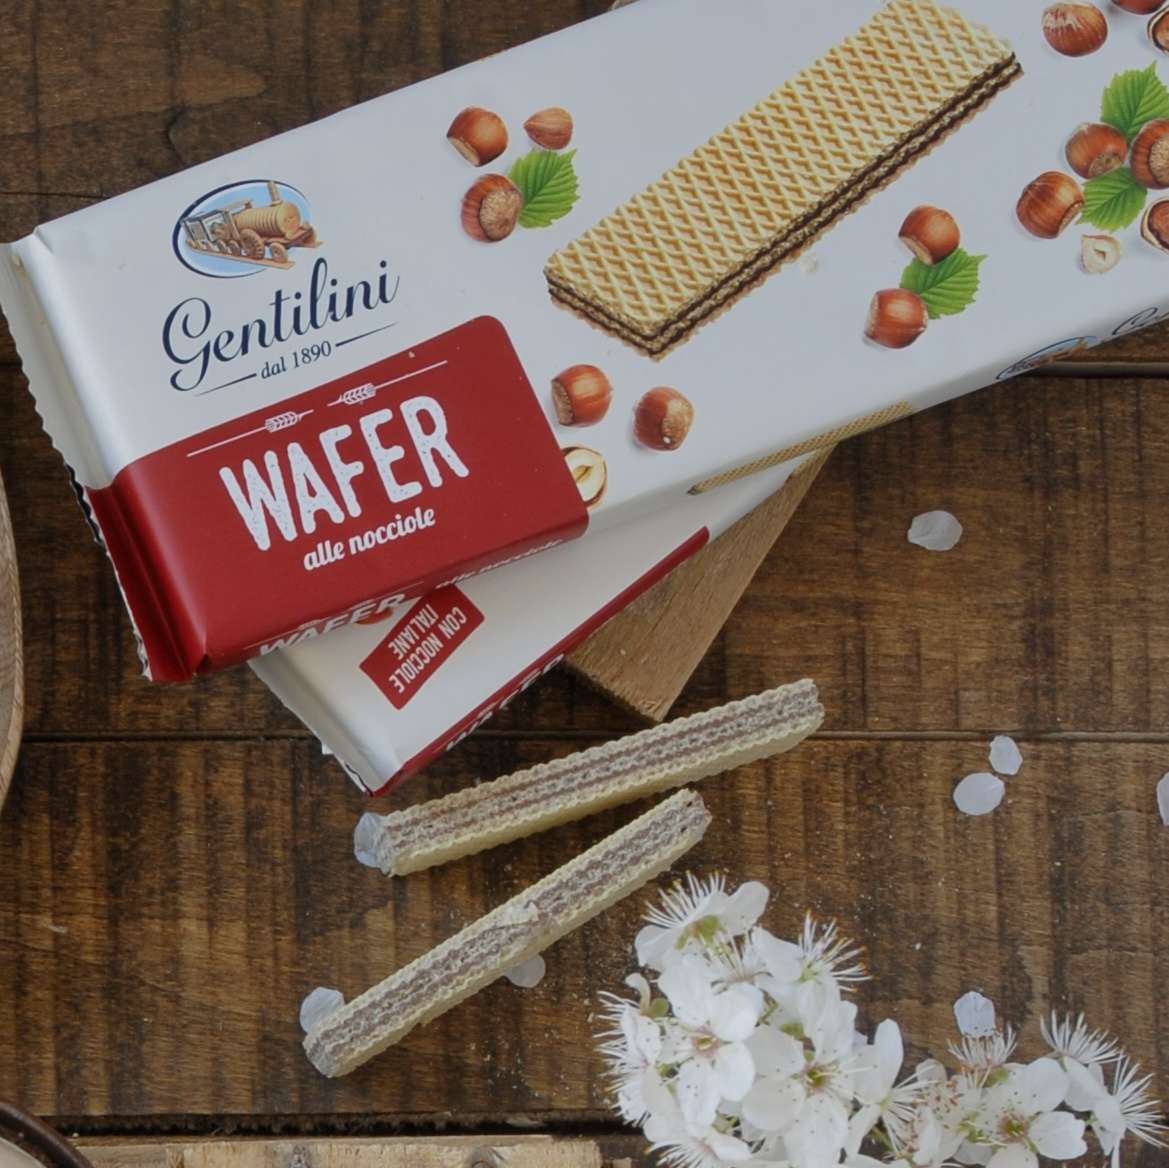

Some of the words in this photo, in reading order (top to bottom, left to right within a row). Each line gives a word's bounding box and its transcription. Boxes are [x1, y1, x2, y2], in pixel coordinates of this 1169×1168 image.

[162, 257, 400, 391] Gentilini
[261, 357, 287, 380] dal
[293, 340, 332, 369] 1890
[219, 395, 470, 551] WAFER
[304, 540, 345, 571] alle
[348, 506, 436, 556] nocciole
[387, 603, 439, 661] ITALIANE
[438, 606, 467, 639] CON
[388, 632, 444, 694] NOCCIOLE
